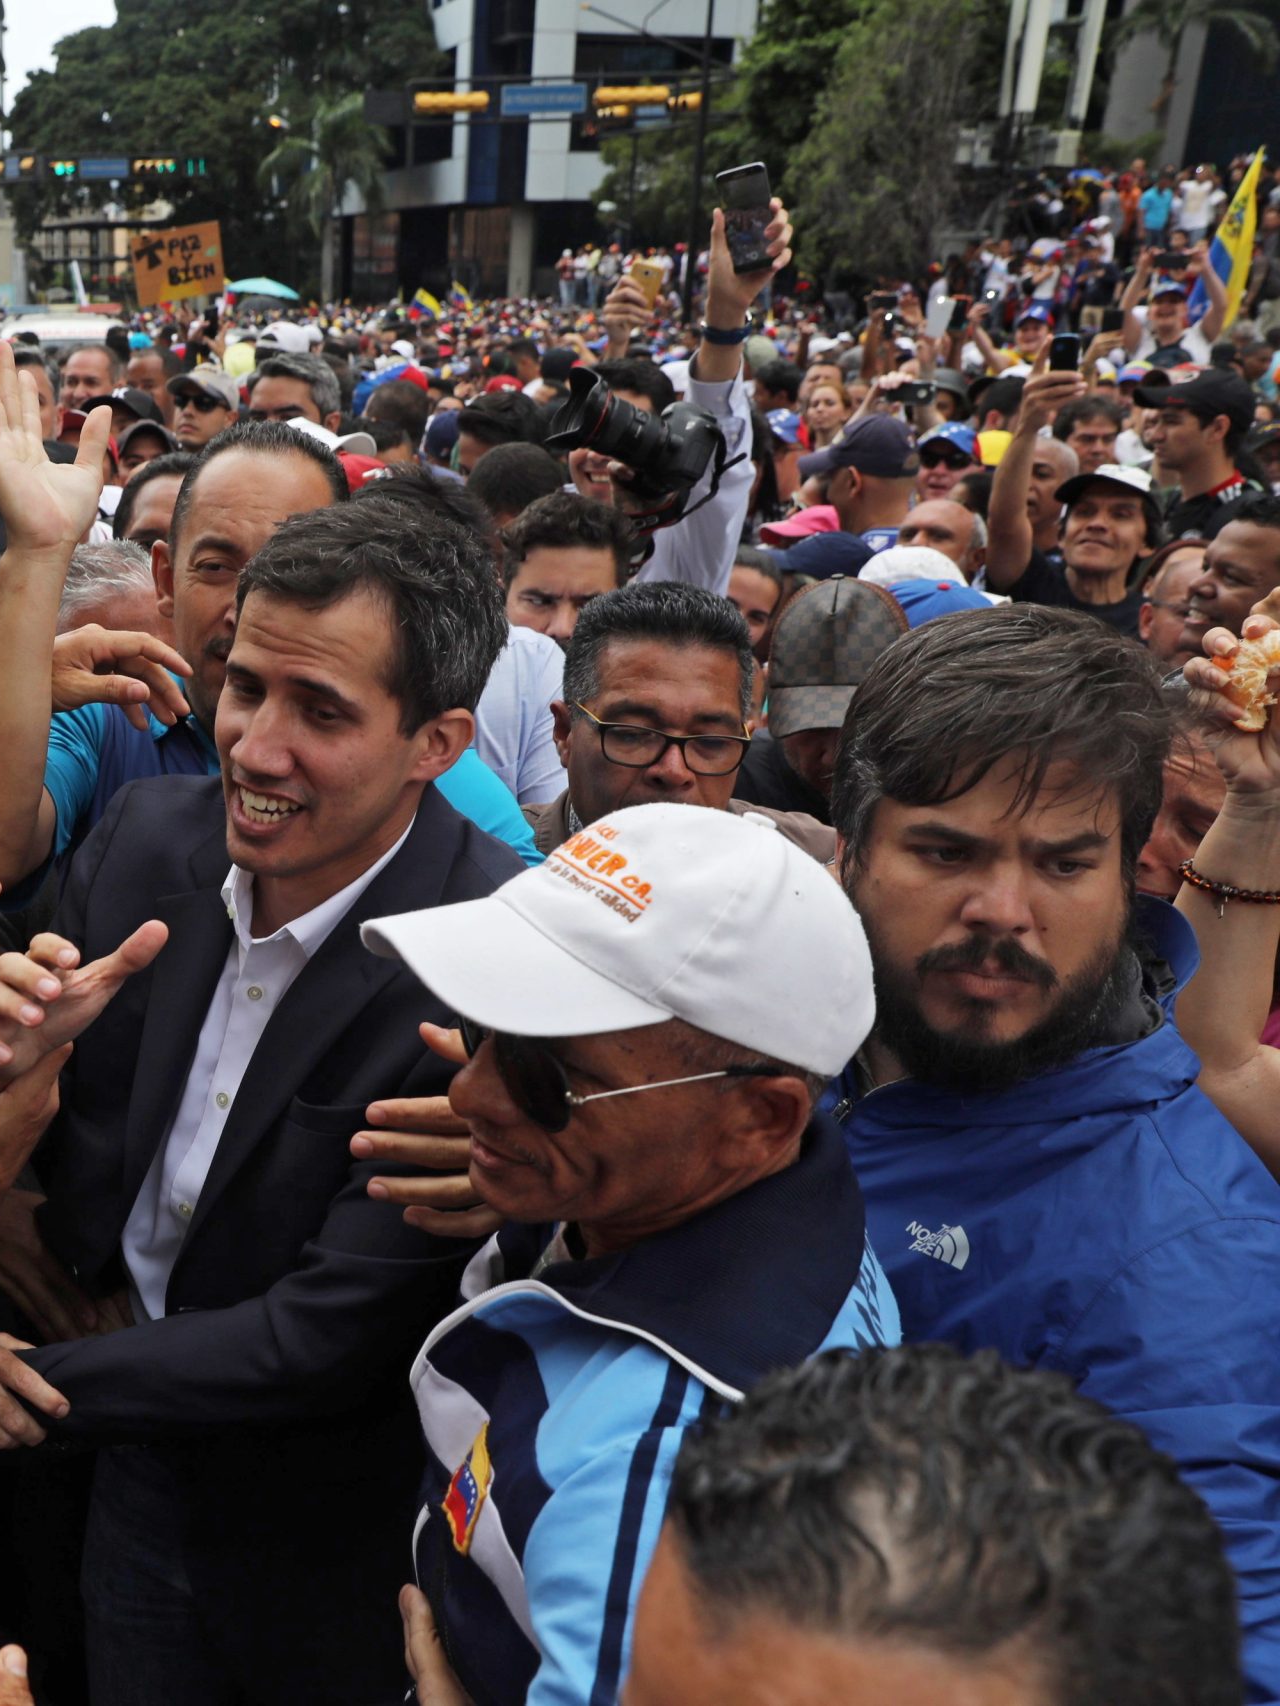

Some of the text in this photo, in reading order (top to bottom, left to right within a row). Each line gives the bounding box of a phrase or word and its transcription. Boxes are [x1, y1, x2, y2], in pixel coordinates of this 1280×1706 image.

[168, 234, 200, 257] PAZ
[168, 262, 215, 286] BIEN
[595, 889, 642, 923] calidad
